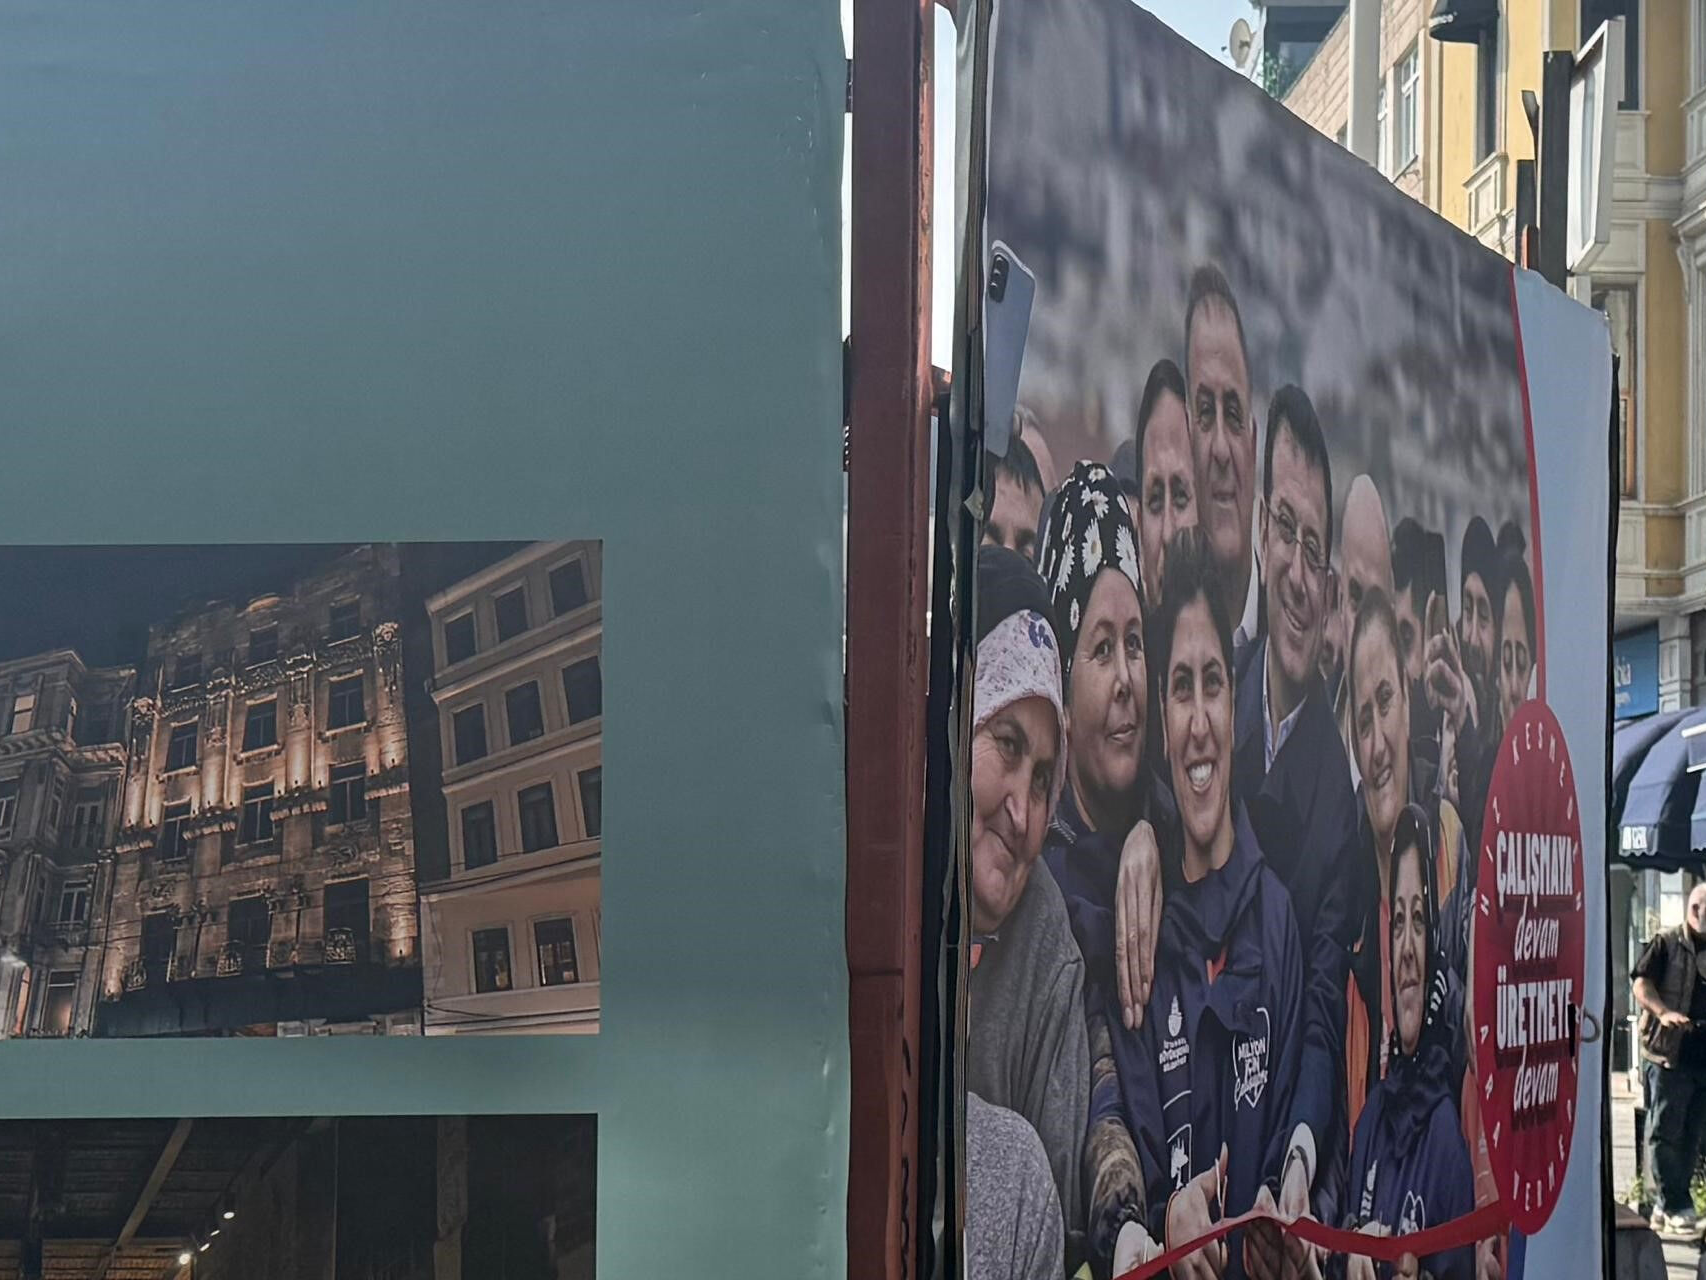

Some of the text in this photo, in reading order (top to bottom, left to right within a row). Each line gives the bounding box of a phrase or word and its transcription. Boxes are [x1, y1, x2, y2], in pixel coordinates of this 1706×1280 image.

[1496, 830, 1573, 908] ÇALIŞMAYA
[1514, 896, 1559, 961] devam
[1513, 1045, 1559, 1112] devam
